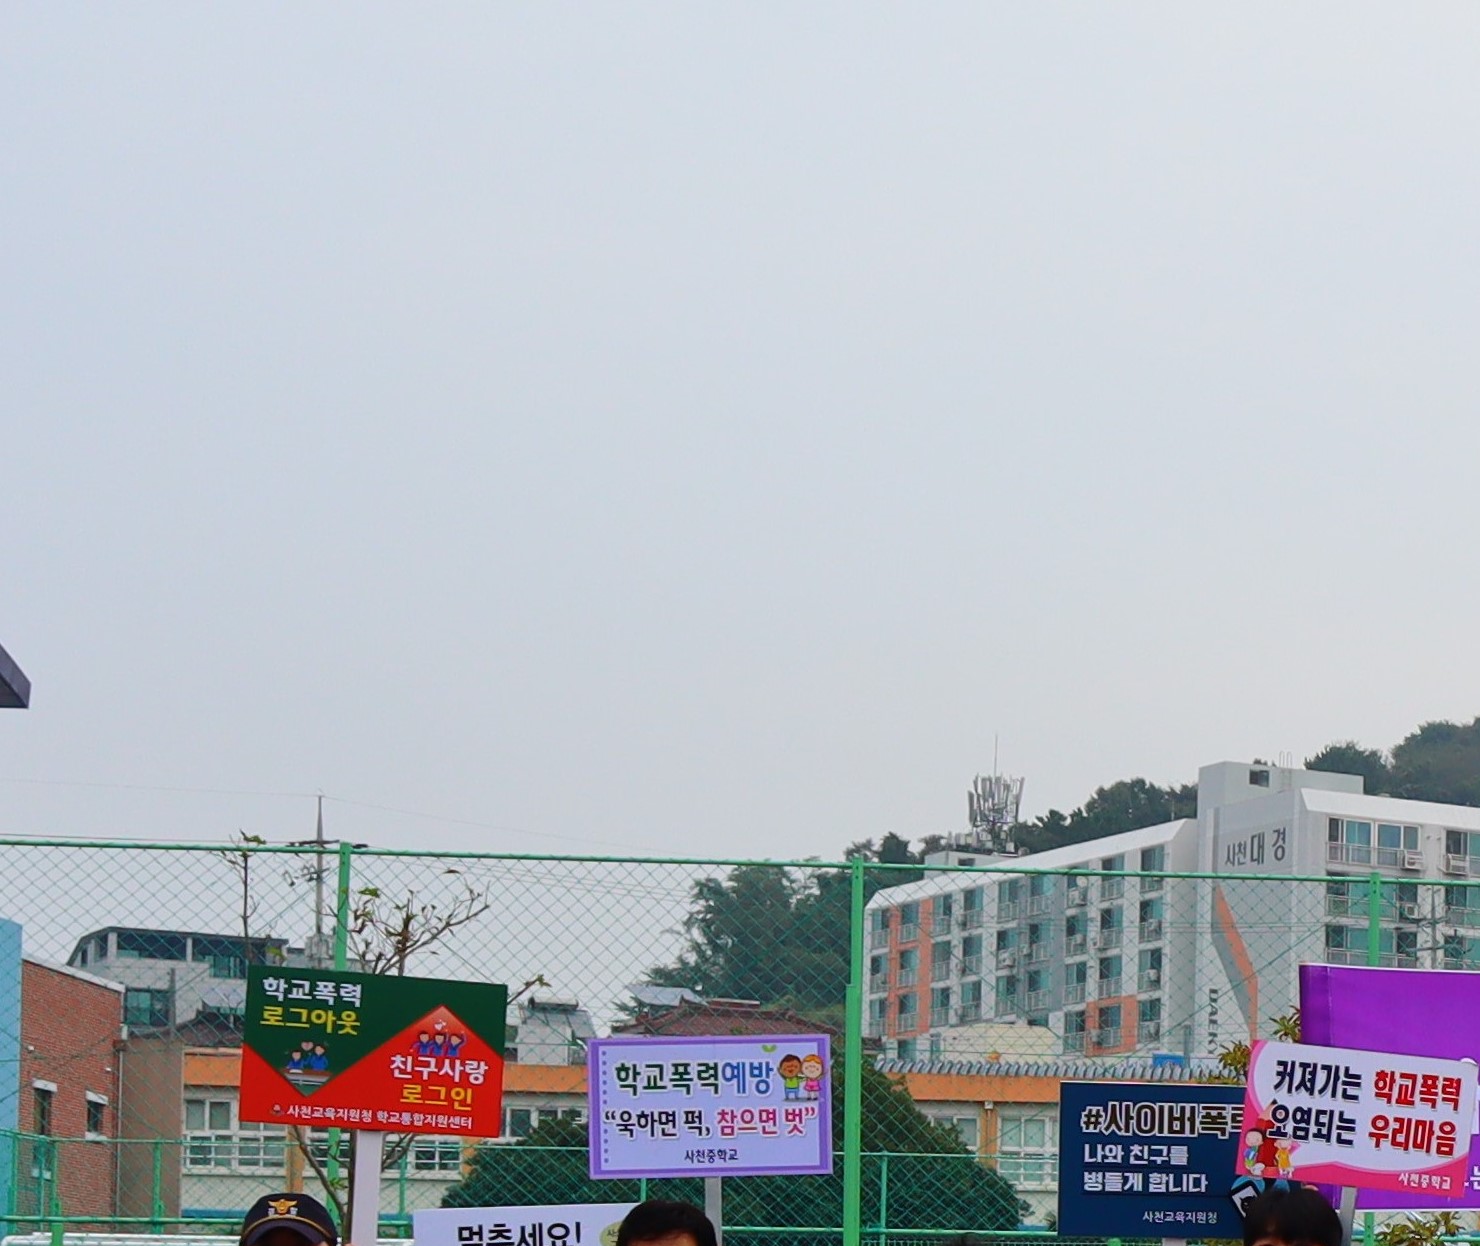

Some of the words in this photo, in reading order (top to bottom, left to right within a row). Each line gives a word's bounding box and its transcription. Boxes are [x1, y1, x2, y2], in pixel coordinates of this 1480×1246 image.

[263, 976, 362, 1008] 학교폭력
[260, 1006, 360, 1035] 로그아웃
[390, 1054, 488, 1085] 친구사랑
[615, 1062, 774, 1096] 학교폭력예방
[400, 1084, 473, 1110] 로그인
[1273, 1059, 1361, 1102] 커져가는
[1374, 1069, 1462, 1111] 학교폭력
[286, 1105, 372, 1123] 사천교육지원청
[377, 1110, 473, 1129] 학교통합지원센터
[717, 1107, 778, 1136] 참으면
[1266, 1104, 1356, 1146] 오염되는
[1368, 1115, 1457, 1157] 우리마음
[684, 1149, 738, 1164] 사천중학교
[1083, 1144, 1124, 1165] 나와
[1129, 1144, 1189, 1166] 친구를
[1083, 1171, 1142, 1193] 병들게
[1148, 1172, 1208, 1194] 합니다
[1398, 1173, 1452, 1190] 사천중학교
[1142, 1210, 1218, 1225] 사천교육지원청
